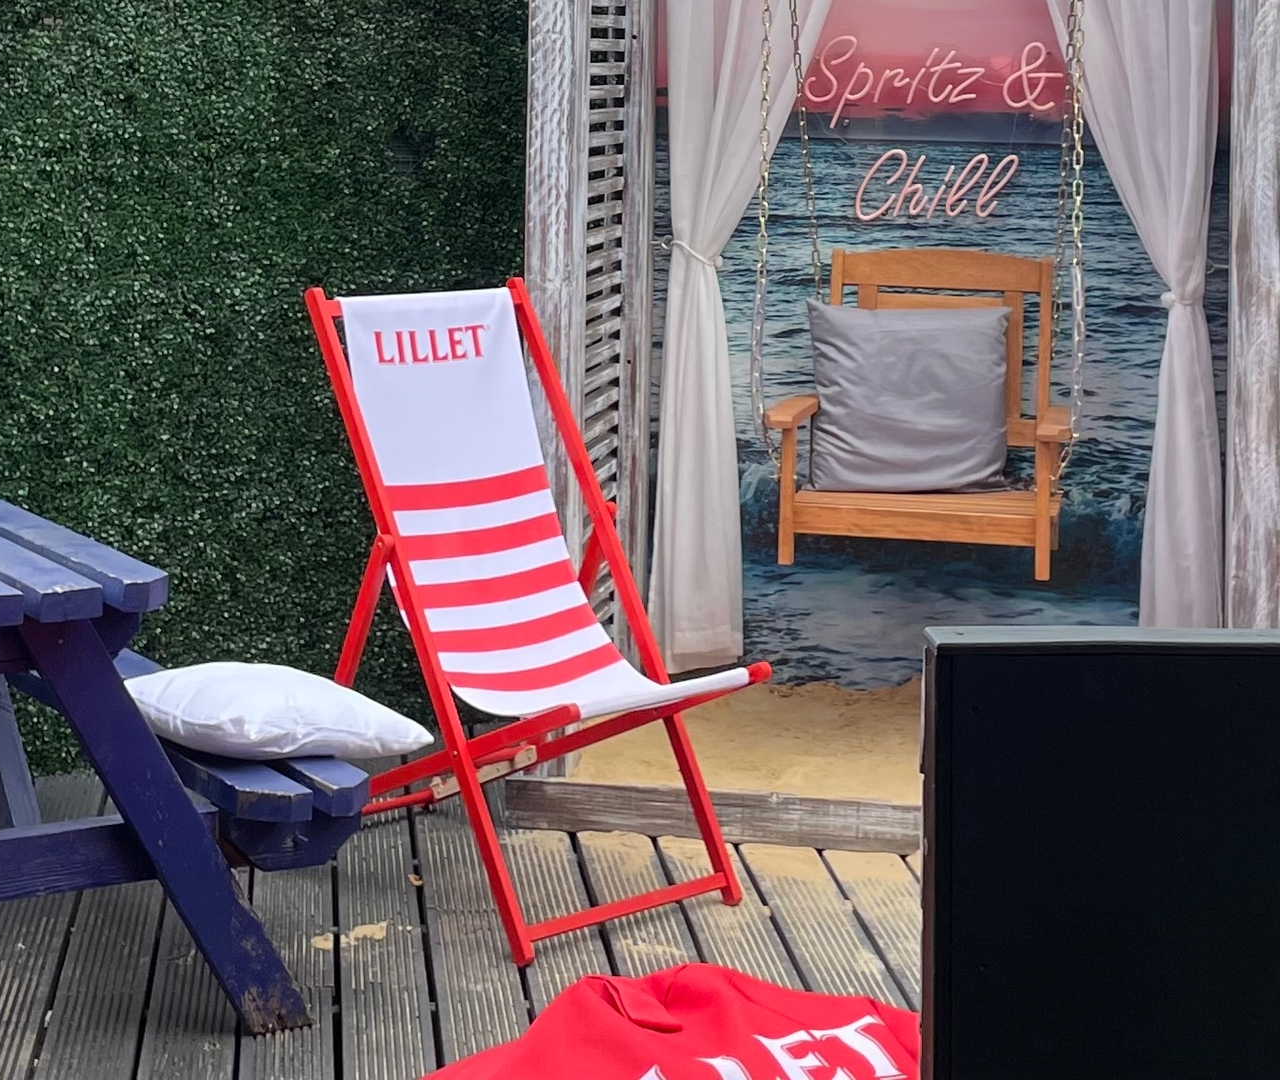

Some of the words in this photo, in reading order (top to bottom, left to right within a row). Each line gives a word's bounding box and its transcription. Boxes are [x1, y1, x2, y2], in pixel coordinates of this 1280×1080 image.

[803, 34, 986, 129] Spritz
[1002, 41, 1064, 111] &
[854, 148, 1020, 222] Chill
[373, 324, 486, 366] LILLET
